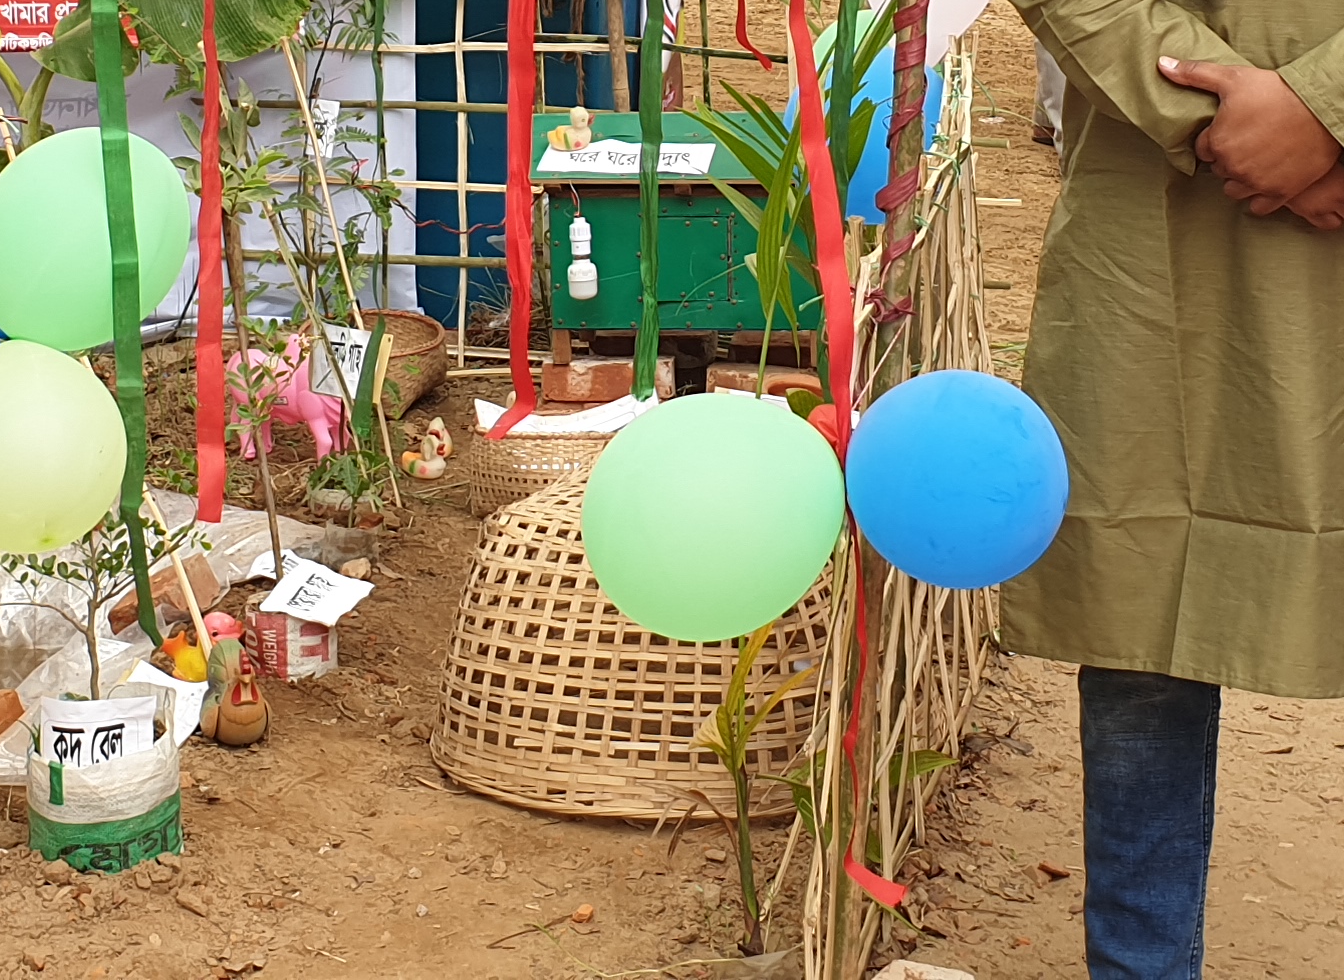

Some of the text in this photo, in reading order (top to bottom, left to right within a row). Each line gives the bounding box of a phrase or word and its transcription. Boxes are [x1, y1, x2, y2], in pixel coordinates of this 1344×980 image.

[0, 0, 51, 26] খামার
[570, 150, 638, 166] ঘরে ঘরে
[91, 723, 125, 765] বেল
